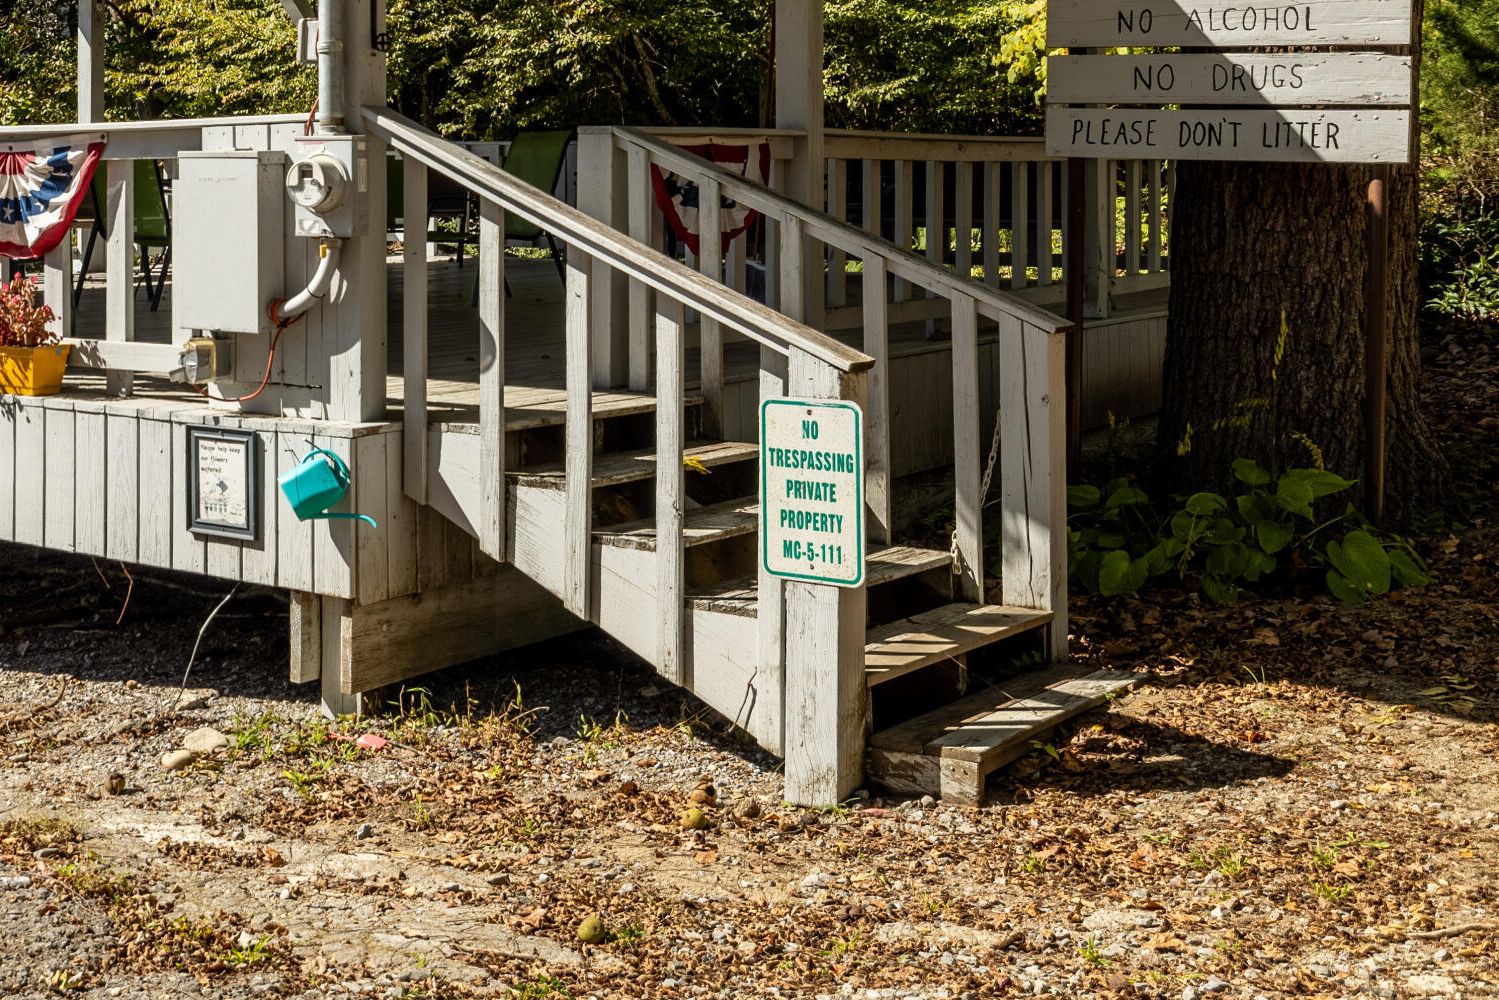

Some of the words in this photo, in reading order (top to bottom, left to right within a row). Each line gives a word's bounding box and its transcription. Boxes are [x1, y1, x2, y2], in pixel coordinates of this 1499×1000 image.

[1118, 9, 1152, 33] NO
[1184, 6, 1318, 32] ALCOHOL
[1133, 64, 1175, 91] NO
[1212, 63, 1304, 91] DRUGS
[1072, 119, 1157, 146] PLEASE
[1179, 117, 1242, 148] DON'T
[1262, 121, 1340, 149] LITTER
[802, 420, 819, 440] NO
[768, 447, 854, 474] TRESPASSING
[786, 479, 837, 503] PRIVATE
[780, 508, 844, 534] PROPERTY
[783, 539, 842, 565] MC-5-111
